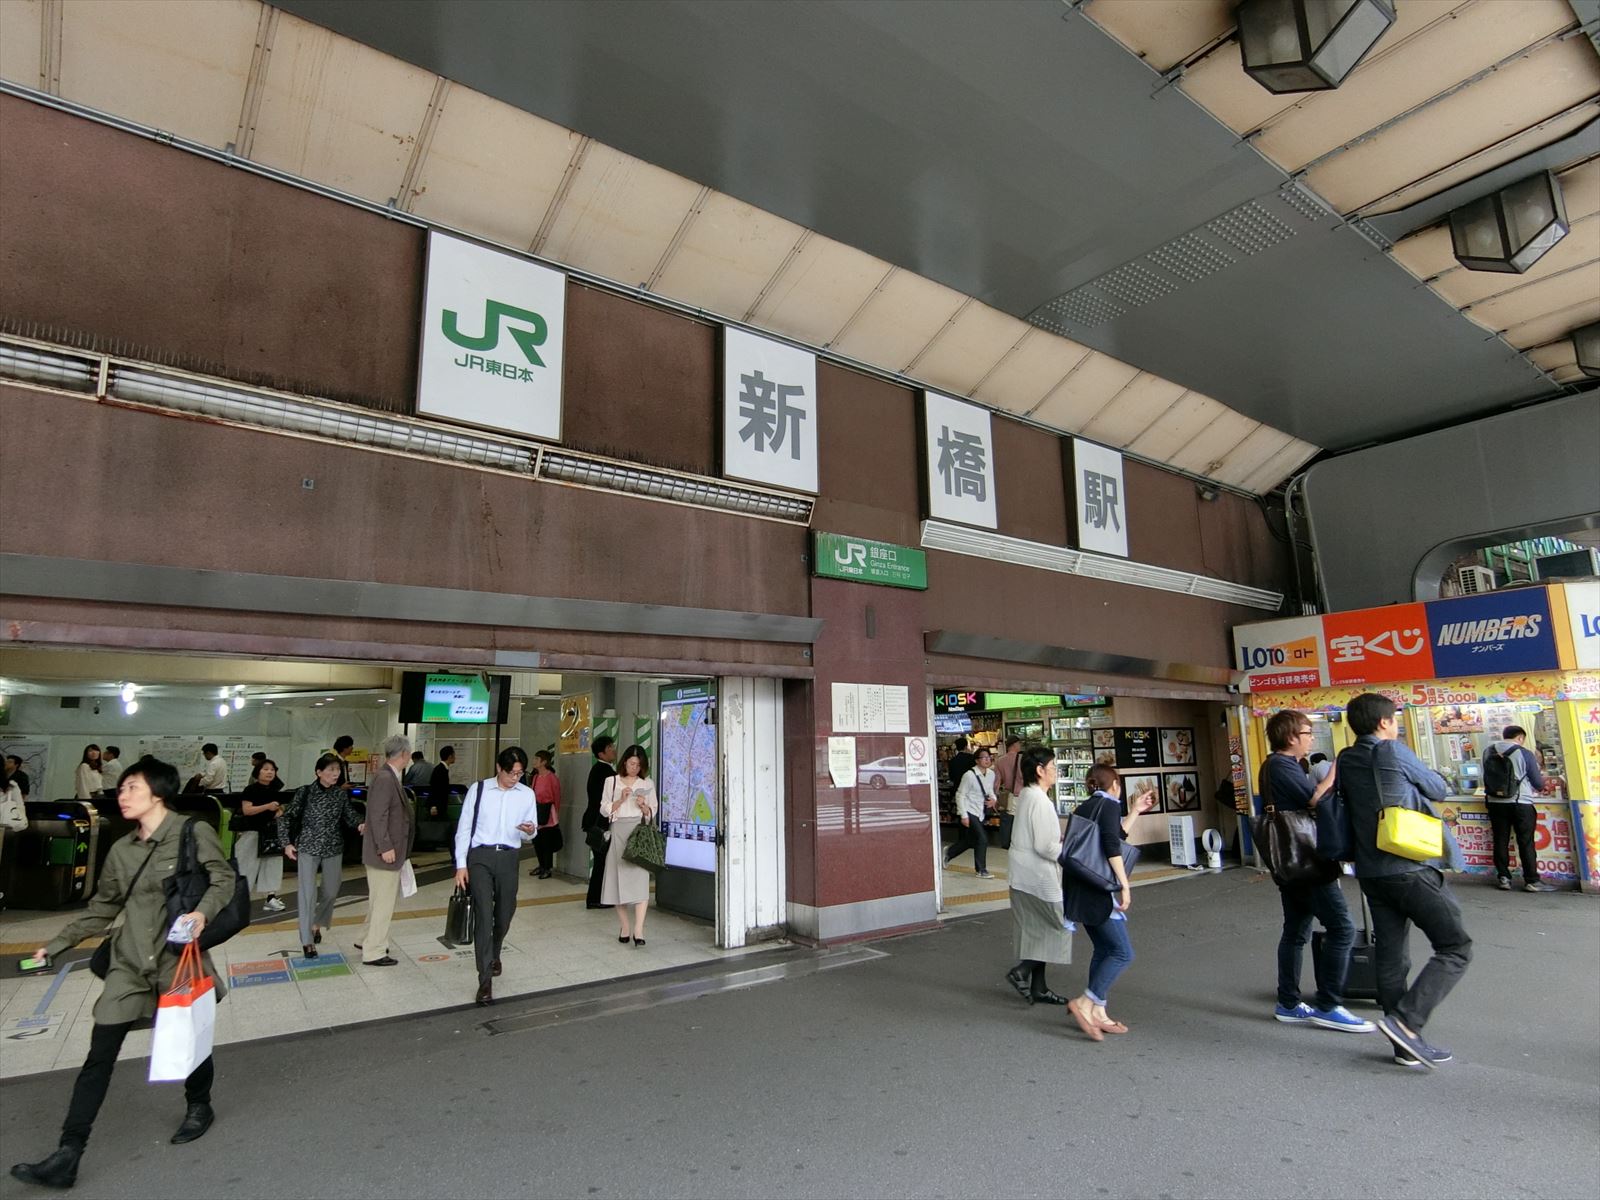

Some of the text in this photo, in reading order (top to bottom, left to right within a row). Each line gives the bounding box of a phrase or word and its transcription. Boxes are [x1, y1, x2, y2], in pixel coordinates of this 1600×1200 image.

[441, 299, 548, 368] JR
[455, 353, 534, 383] JR東日本
[835, 543, 867, 568] JR
[870, 546, 897, 561] 銀座口
[870, 559, 910, 572] Ginza Entrance
[1437, 614, 1542, 647] NUMBERS
[1294, 648, 1314, 659] ロト
[1330, 628, 1424, 664] 宝くじ
[1472, 643, 1505, 653] ナンバーズ
[1241, 646, 1285, 671] LOTO
[1249, 674, 1317, 687] ビンゴ5好評発売中
[936, 692, 977, 707] KIOSK
[1124, 730, 1150, 739] KIOSK
